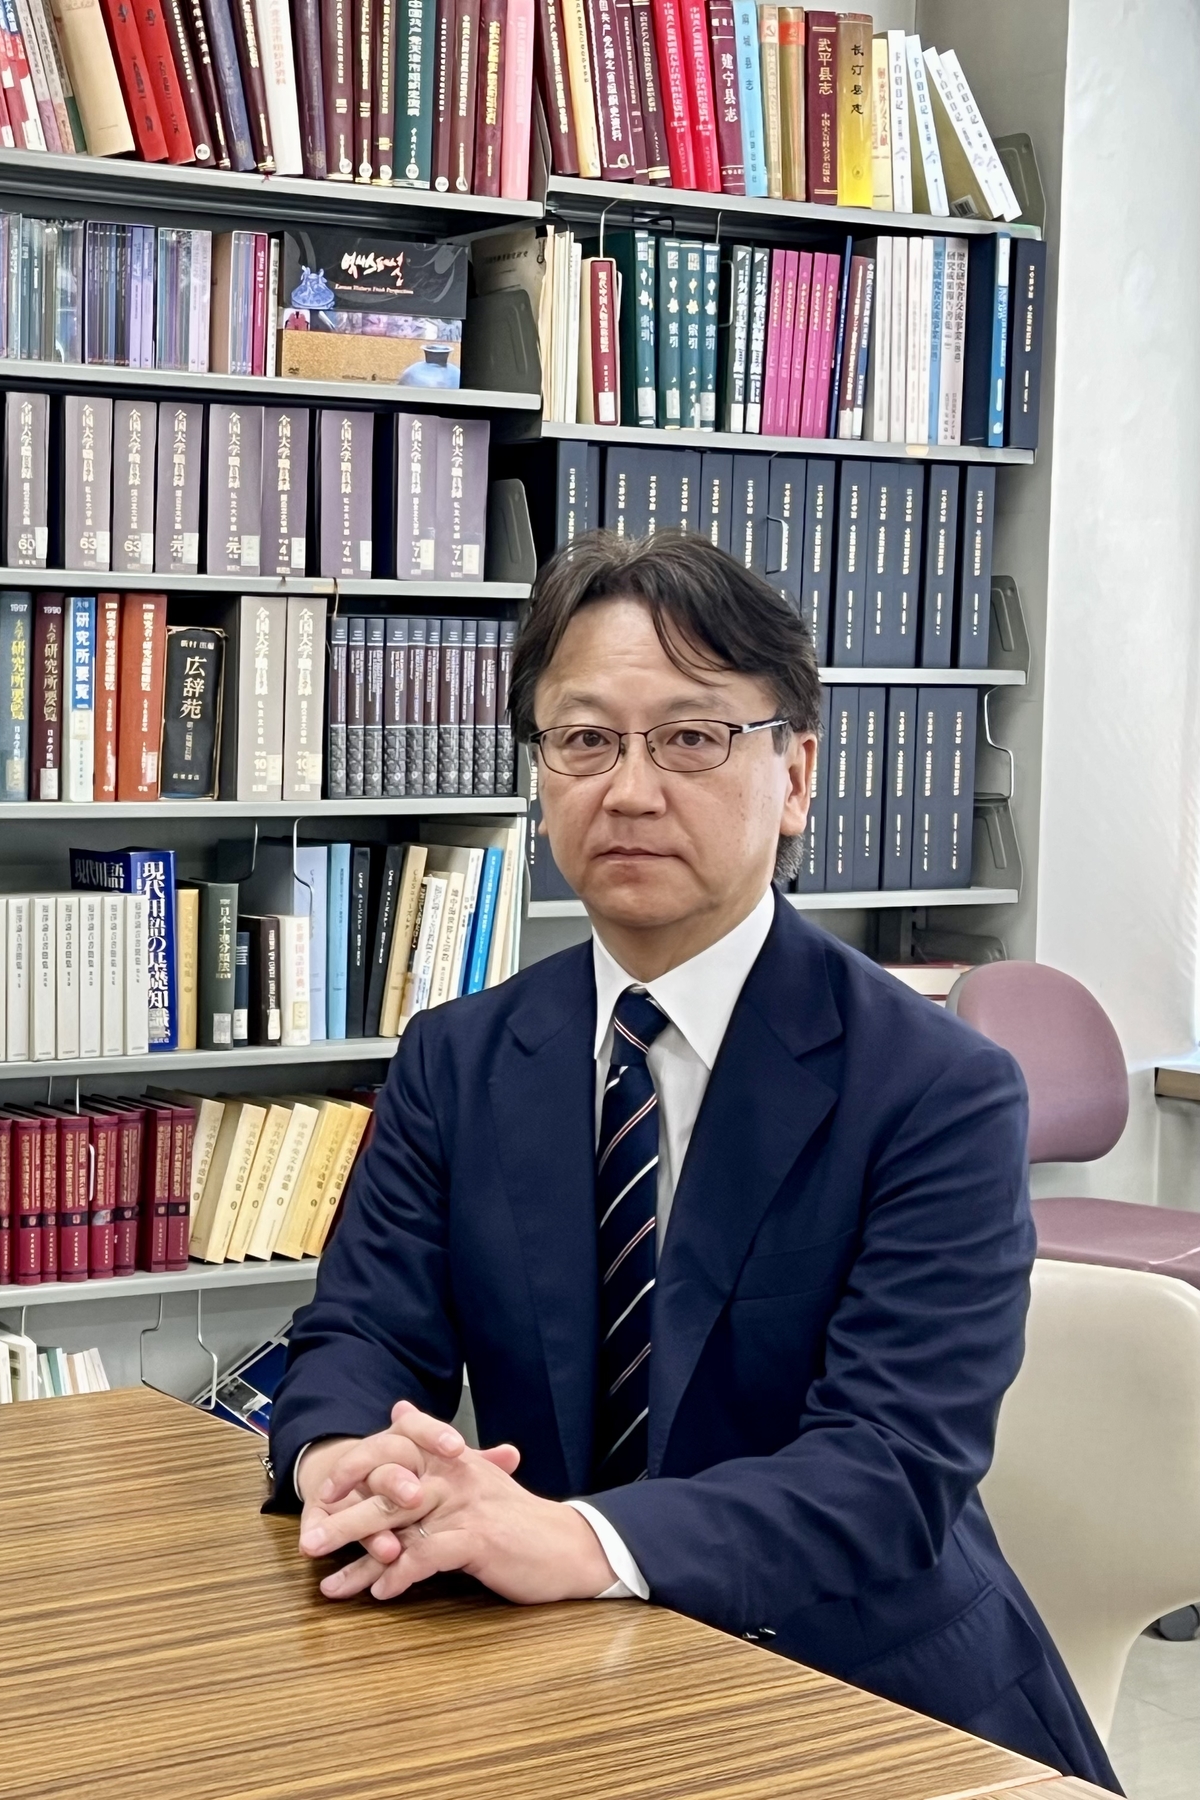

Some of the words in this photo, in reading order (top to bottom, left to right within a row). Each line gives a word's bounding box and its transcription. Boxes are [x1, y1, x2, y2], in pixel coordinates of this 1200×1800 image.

[817, 37, 834, 95] 武平县志
[721, 53, 739, 123] 建宁县志
[18, 539, 35, 550] 60
[80, 538, 97, 549] 63
[124, 541, 141, 552] 63
[226, 543, 241, 553] 元
[10, 604, 28, 612] 1997
[43, 622, 58, 722] 大学研究所要覧
[75, 612, 89, 699] 研究所要覧
[180, 656, 207, 720] 広辞苑
[254, 759, 267, 769] 10
[217, 906, 231, 973] 日本十進分類法
